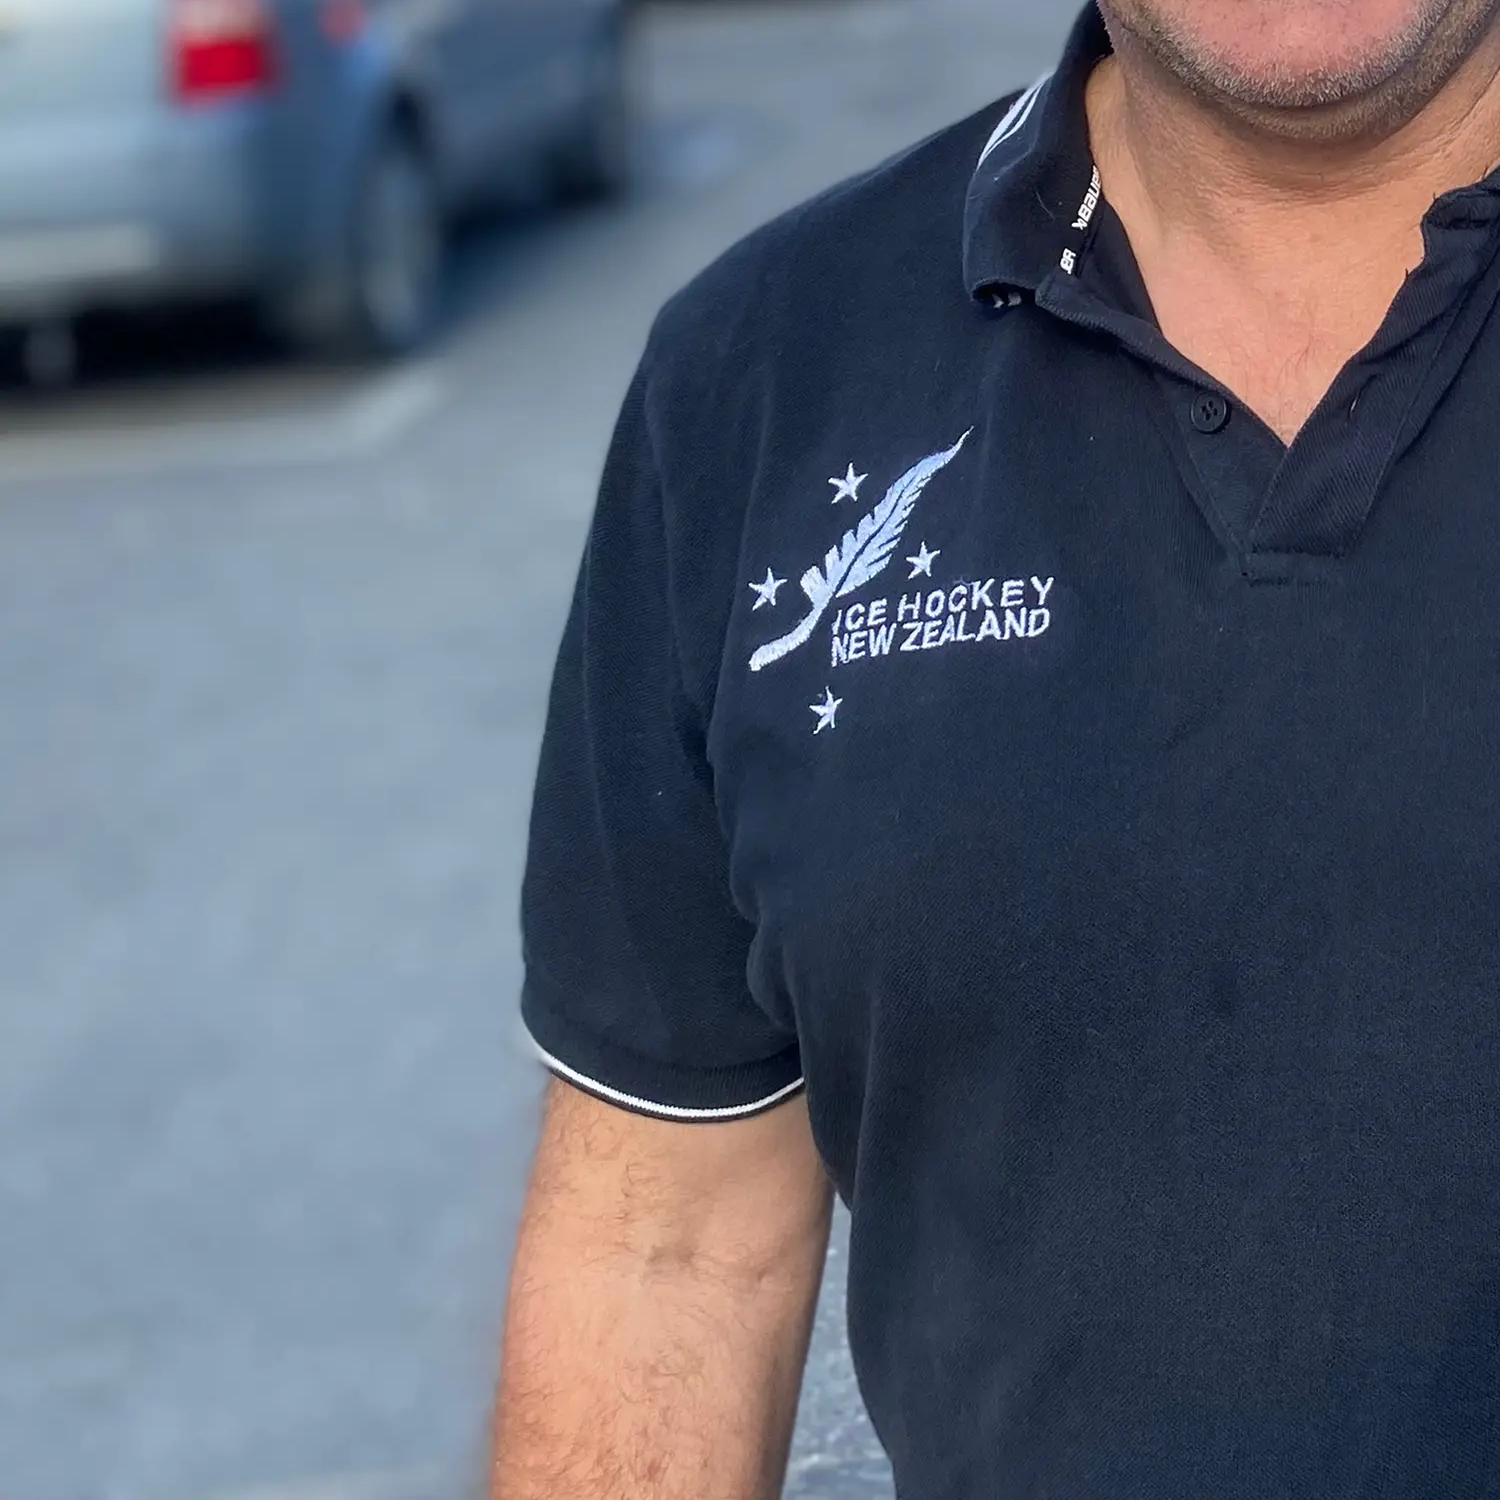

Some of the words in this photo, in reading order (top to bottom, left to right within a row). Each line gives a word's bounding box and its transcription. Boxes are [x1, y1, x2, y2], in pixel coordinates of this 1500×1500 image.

[831, 598, 889, 636] ICE
[897, 575, 1055, 622] HOCKEY
[831, 622, 897, 668] NEW
[899, 606, 1051, 652] ZEALAND
